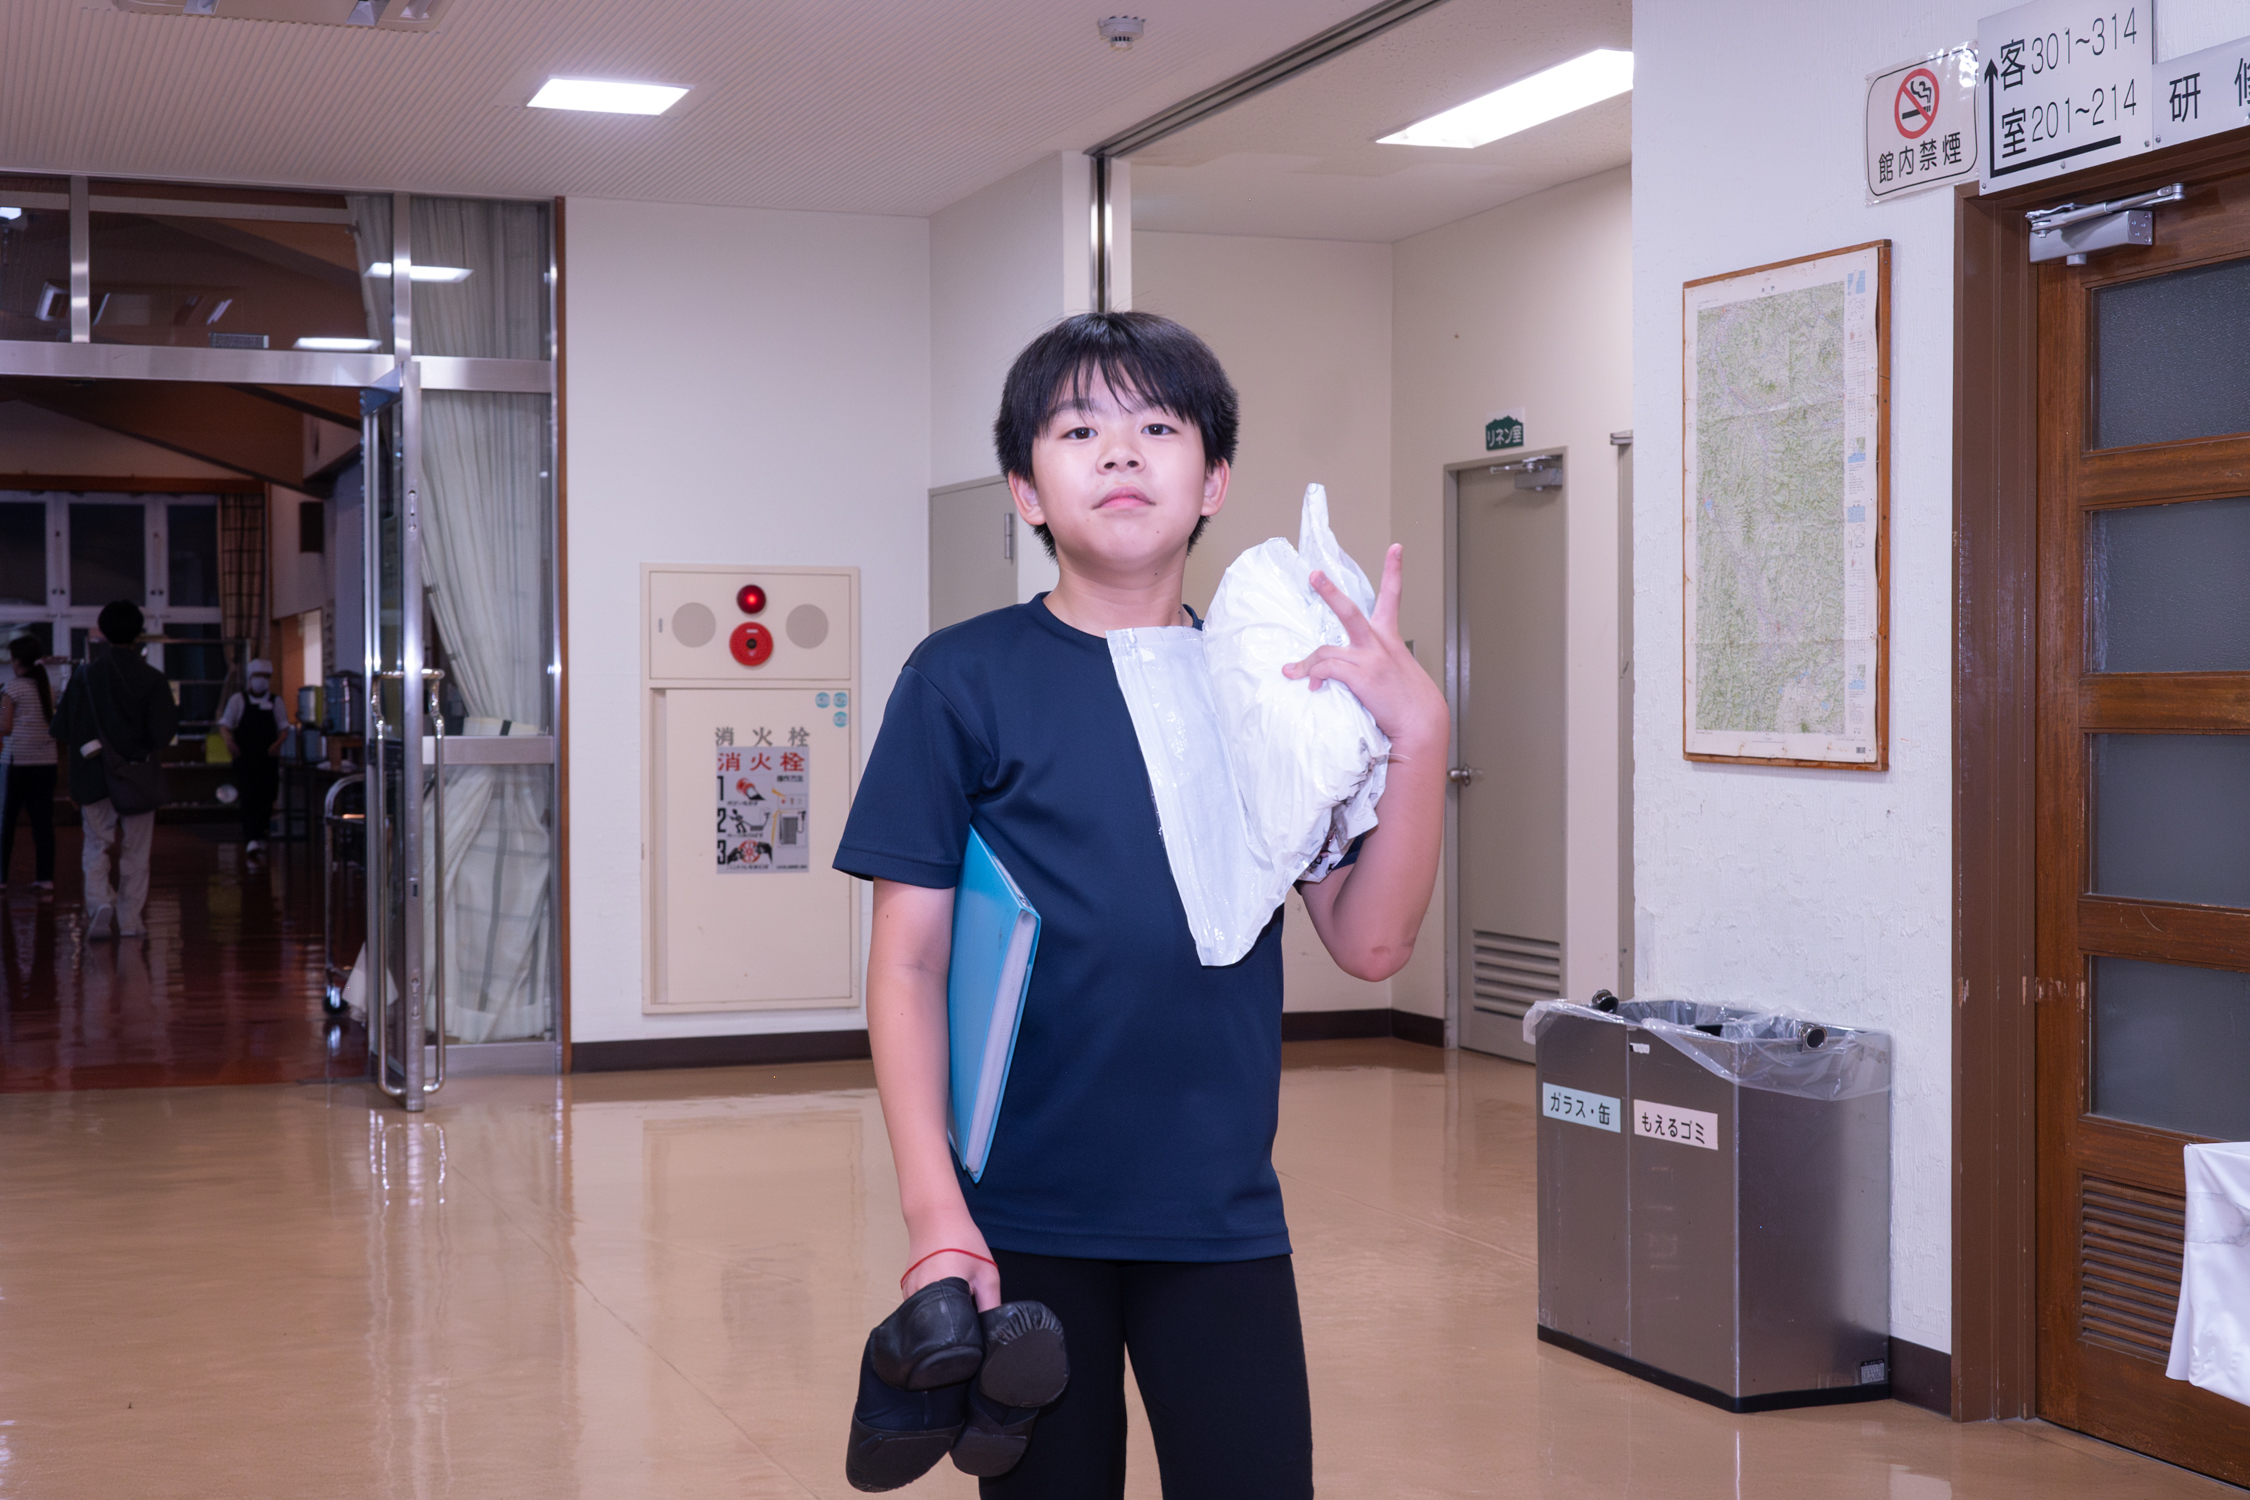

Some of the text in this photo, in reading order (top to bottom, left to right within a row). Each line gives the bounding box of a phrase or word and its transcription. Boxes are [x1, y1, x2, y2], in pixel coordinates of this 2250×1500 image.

[1878, 131, 1962, 184] 館内禁煙
[1487, 425, 1522, 447] リネン室
[715, 726, 810, 747] 消火栓
[717, 752, 805, 772] 消火栓
[717, 775, 724, 801] 1
[717, 808, 726, 833] 2
[717, 840, 726, 865] 3
[1550, 1092, 1611, 1126] ガラス・缶
[1641, 1111, 1705, 1145] もえるゴミ
